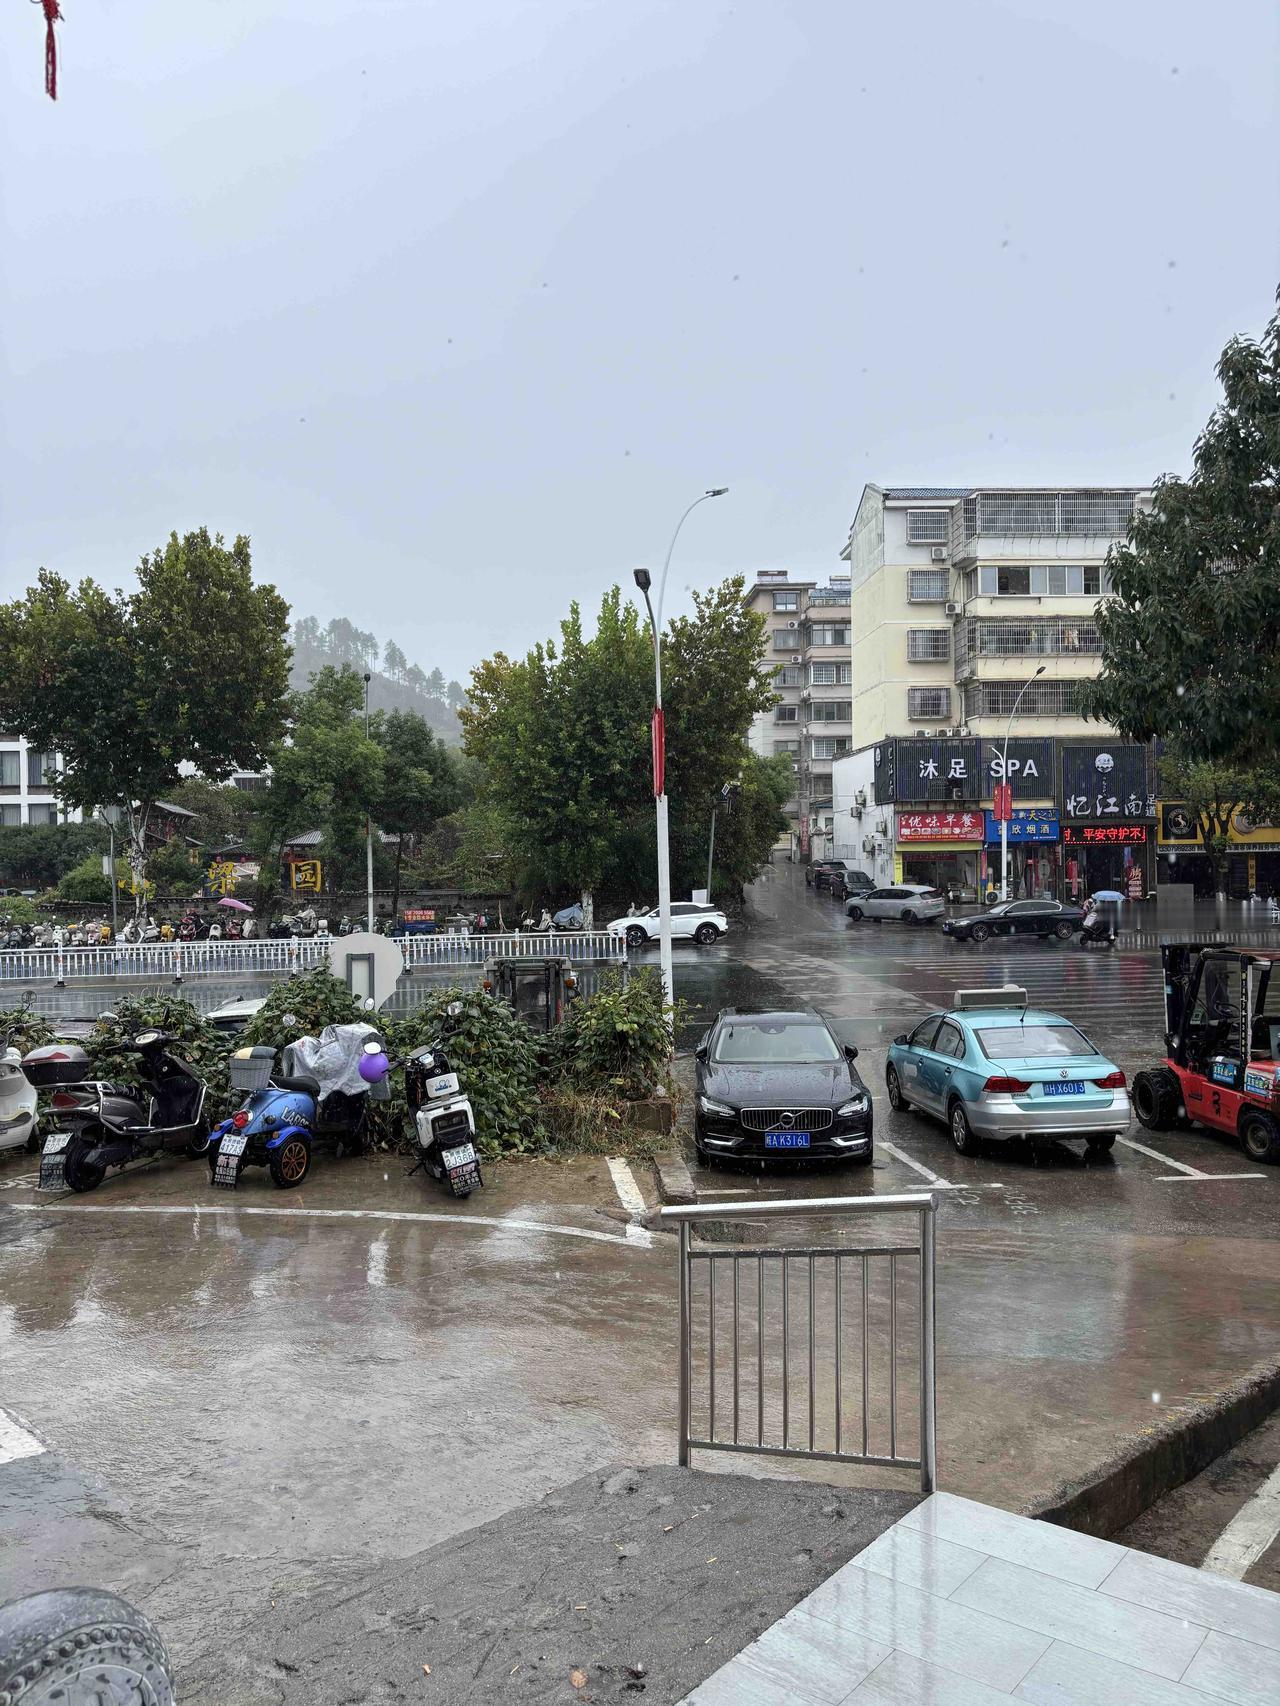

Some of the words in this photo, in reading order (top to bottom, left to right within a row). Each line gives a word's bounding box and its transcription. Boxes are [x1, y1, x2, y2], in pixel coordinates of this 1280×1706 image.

[919, 759, 967, 779] 沐足
[990, 759, 1039, 777] SPA
[1066, 792, 1142, 817] 忆江南
[908, 813, 976, 827] 优味早餐
